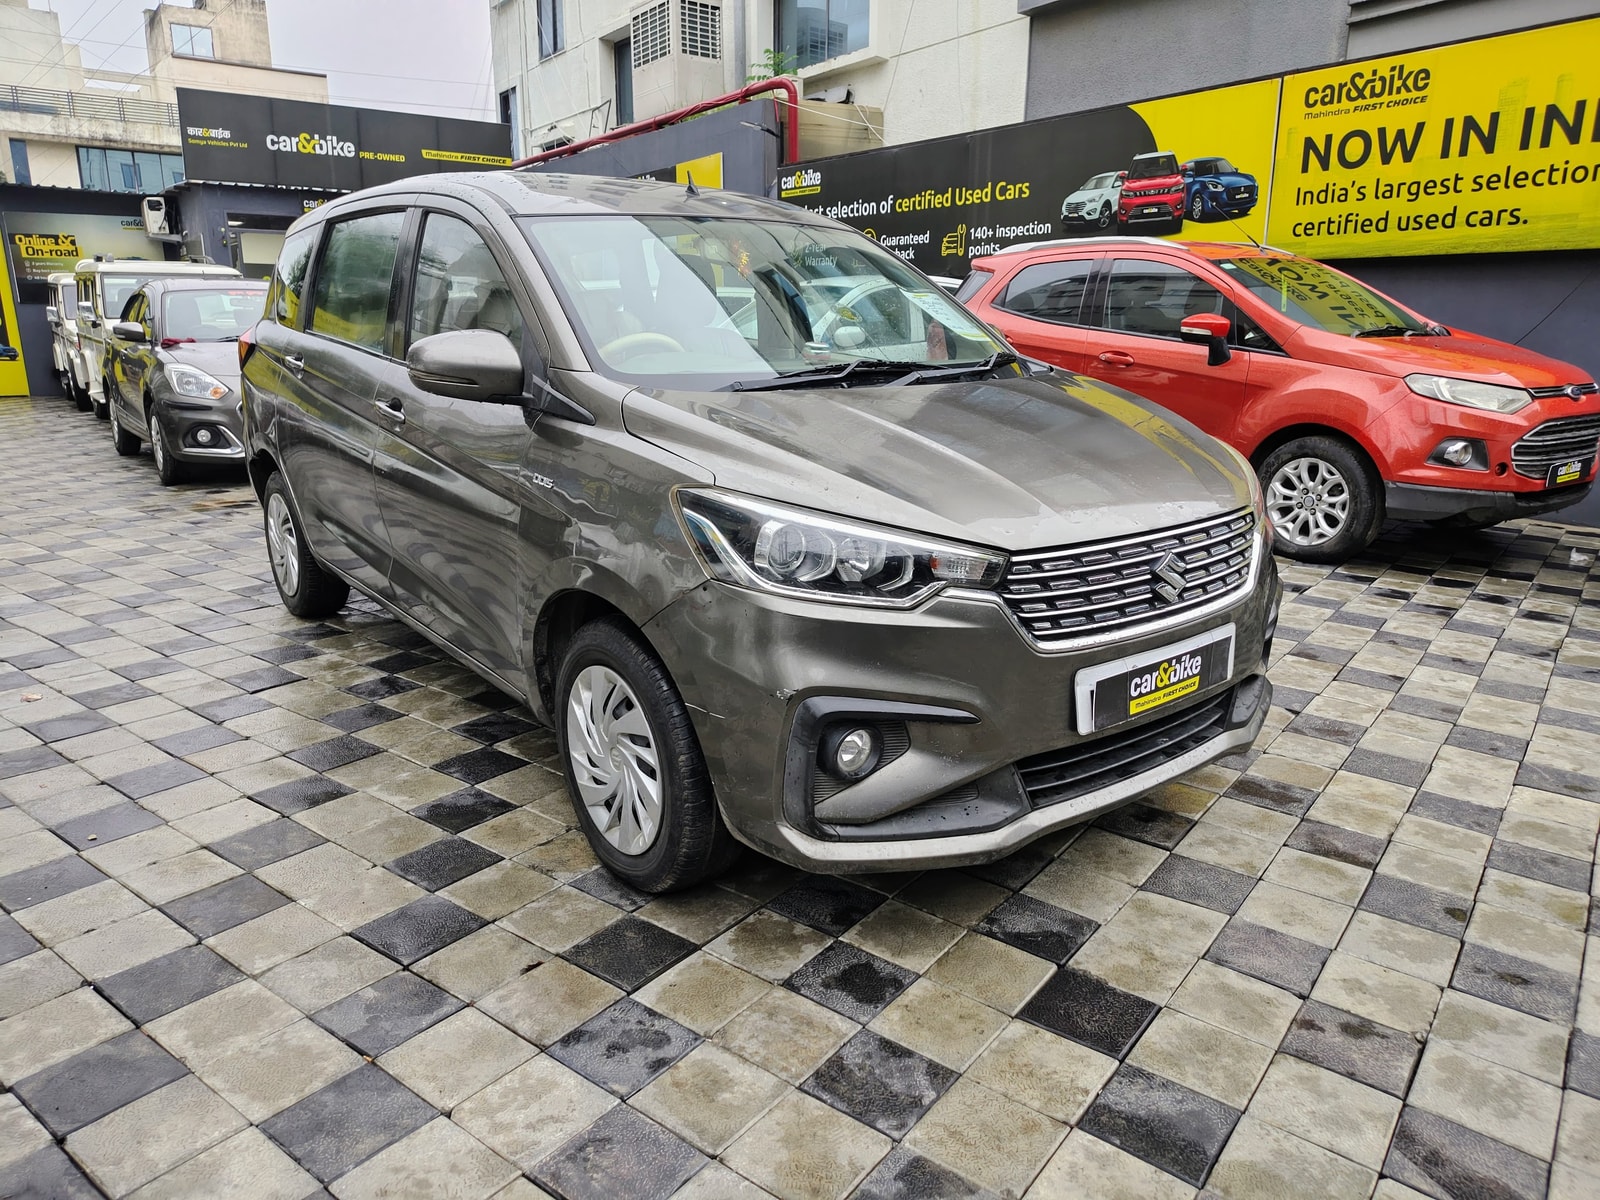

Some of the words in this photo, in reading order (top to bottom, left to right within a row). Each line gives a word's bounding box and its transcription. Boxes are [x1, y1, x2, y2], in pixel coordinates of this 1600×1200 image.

[1304, 64, 1431, 109] car&bike
[1304, 108, 1350, 120] Mahindra
[1352, 102, 1384, 113] FIRST
[1386, 95, 1428, 109] CHOICE
[266, 132, 356, 158] car&bike
[359, 151, 406, 163] PRE-OWNED
[1300, 121, 1426, 174] NOW
[1439, 111, 1500, 160] IN
[425, 151, 459, 160] Mahindra
[460, 154, 481, 162] FIRST
[481, 156, 507, 165] CHOICE
[781, 168, 821, 190] car&bike
[1295, 180, 1367, 206] India's
[1374, 172, 1463, 202] largest
[825, 199, 877, 219] selection
[879, 194, 894, 214] of
[895, 187, 952, 212] certified
[955, 182, 992, 206] Used
[995, 181, 1030, 201] Cars
[969, 226, 993, 240] 140+
[995, 221, 1052, 240] inspection
[1291, 210, 1390, 238] certified
[1397, 205, 1458, 231] used
[1465, 206, 1529, 228] cars.
[15, 234, 56, 246] Online
[880, 230, 930, 246] Guaranteed
[968, 242, 1000, 259] points
[25, 245, 79, 257] On-road
[804, 254, 838, 267] Warranty
[1130, 654, 1202, 697] car&bike
[1135, 695, 1161, 709] Mahindra
[1162, 688, 1179, 699] FIRST
[1178, 680, 1197, 693] CHOICE
